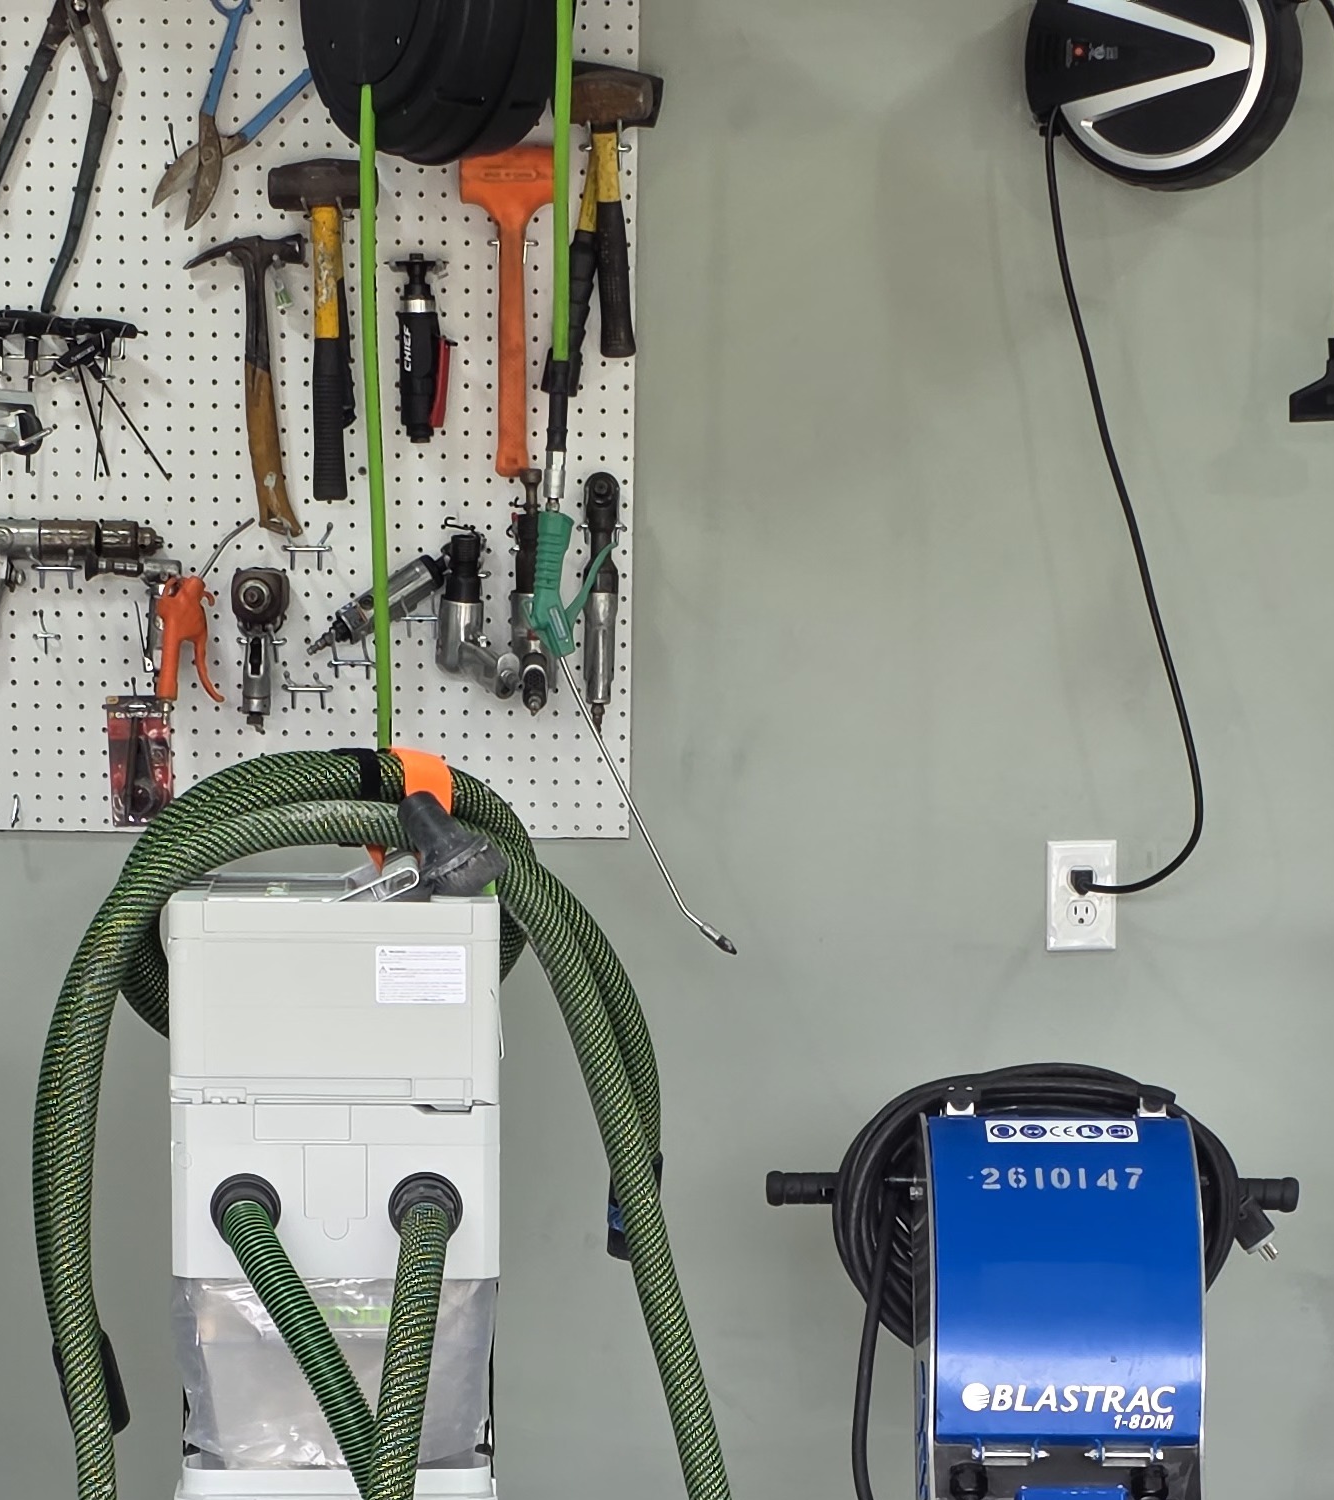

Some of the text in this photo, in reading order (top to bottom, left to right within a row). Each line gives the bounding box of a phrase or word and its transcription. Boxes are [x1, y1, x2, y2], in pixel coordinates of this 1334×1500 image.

[403, 324, 412, 372] CHIEF
[1049, 1126, 1074, 1137] CE
[980, 1167, 1143, 1190] 2610147
[990, 1384, 1176, 1413] BLASTRAC
[1113, 1414, 1174, 1430] 1-8DM
